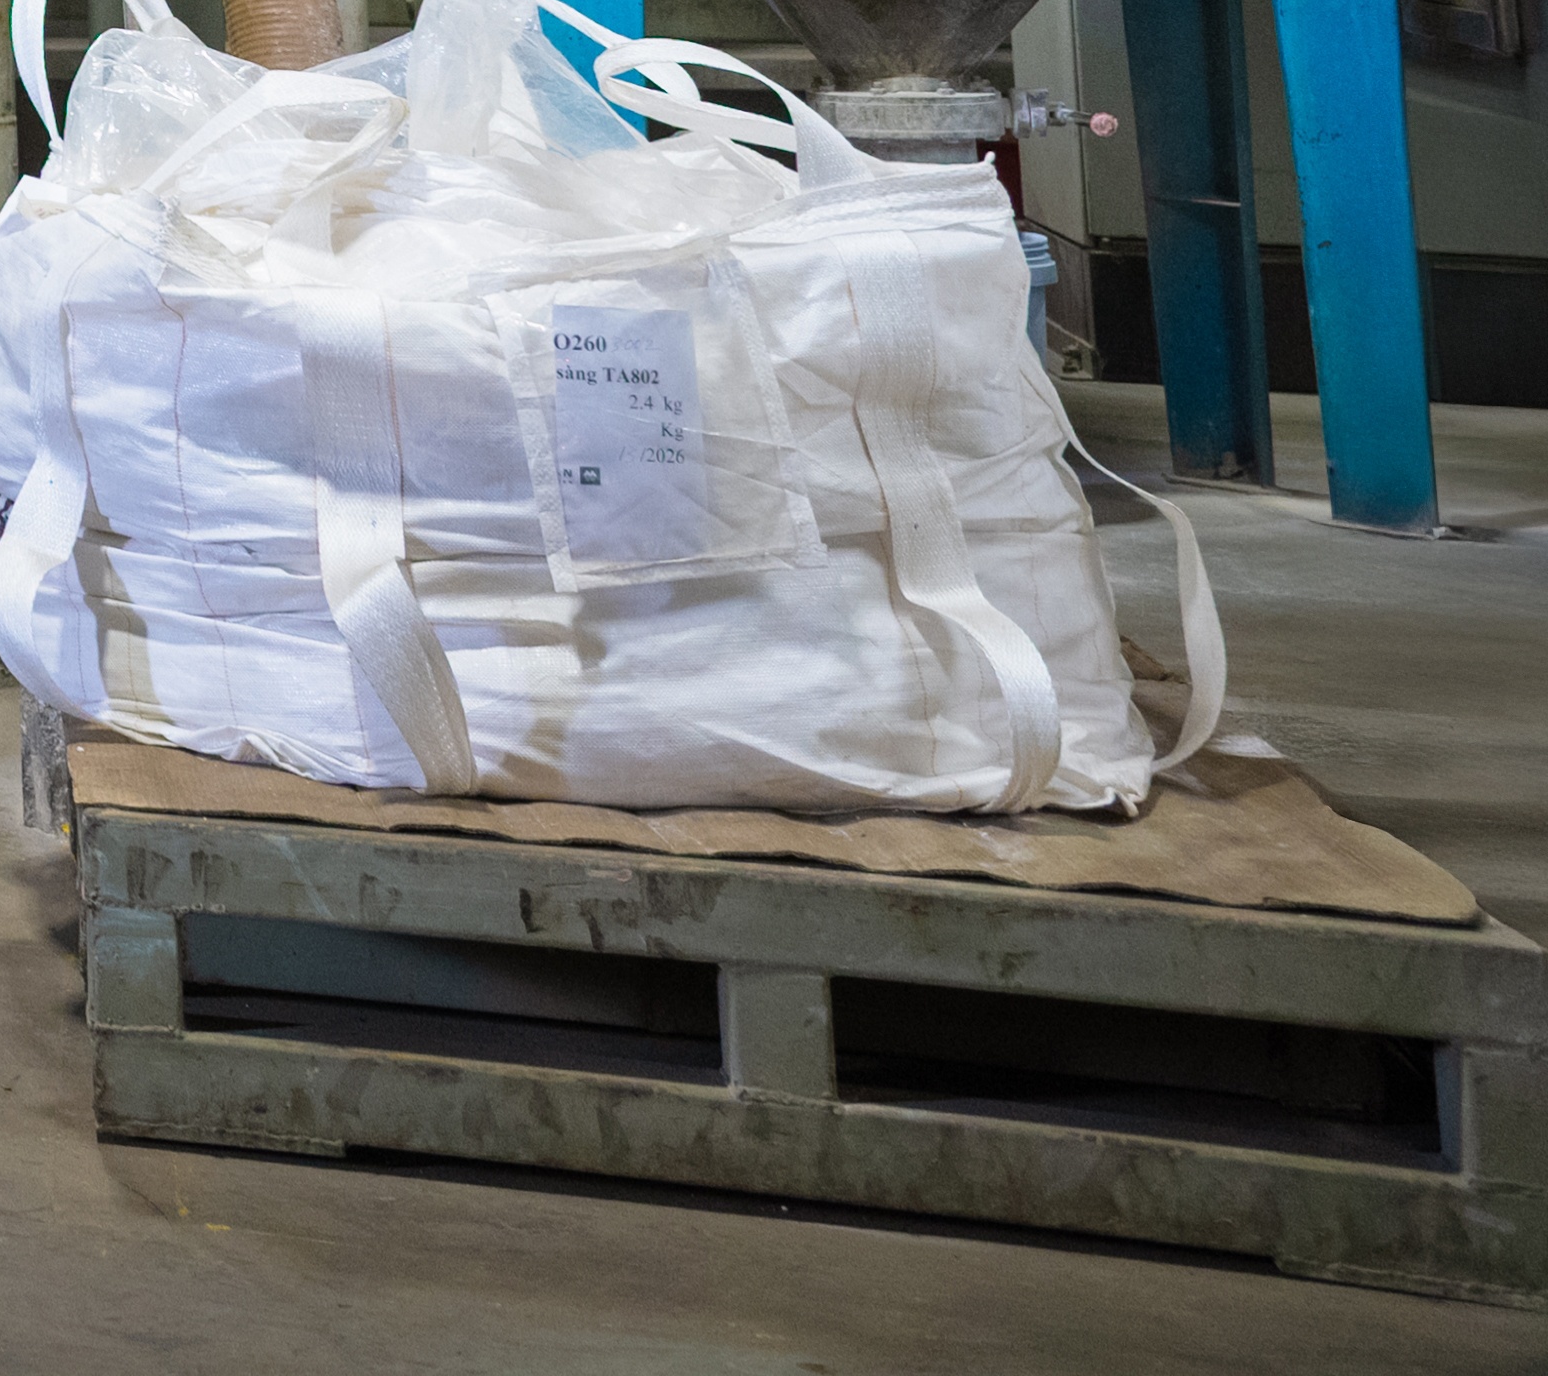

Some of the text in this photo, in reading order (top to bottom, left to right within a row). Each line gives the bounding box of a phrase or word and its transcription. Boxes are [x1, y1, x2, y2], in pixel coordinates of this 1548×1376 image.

[556, 365, 660, 385] sàng TA802
[628, 394, 683, 416] 2.4 kg
[661, 422, 684, 442] Kg
